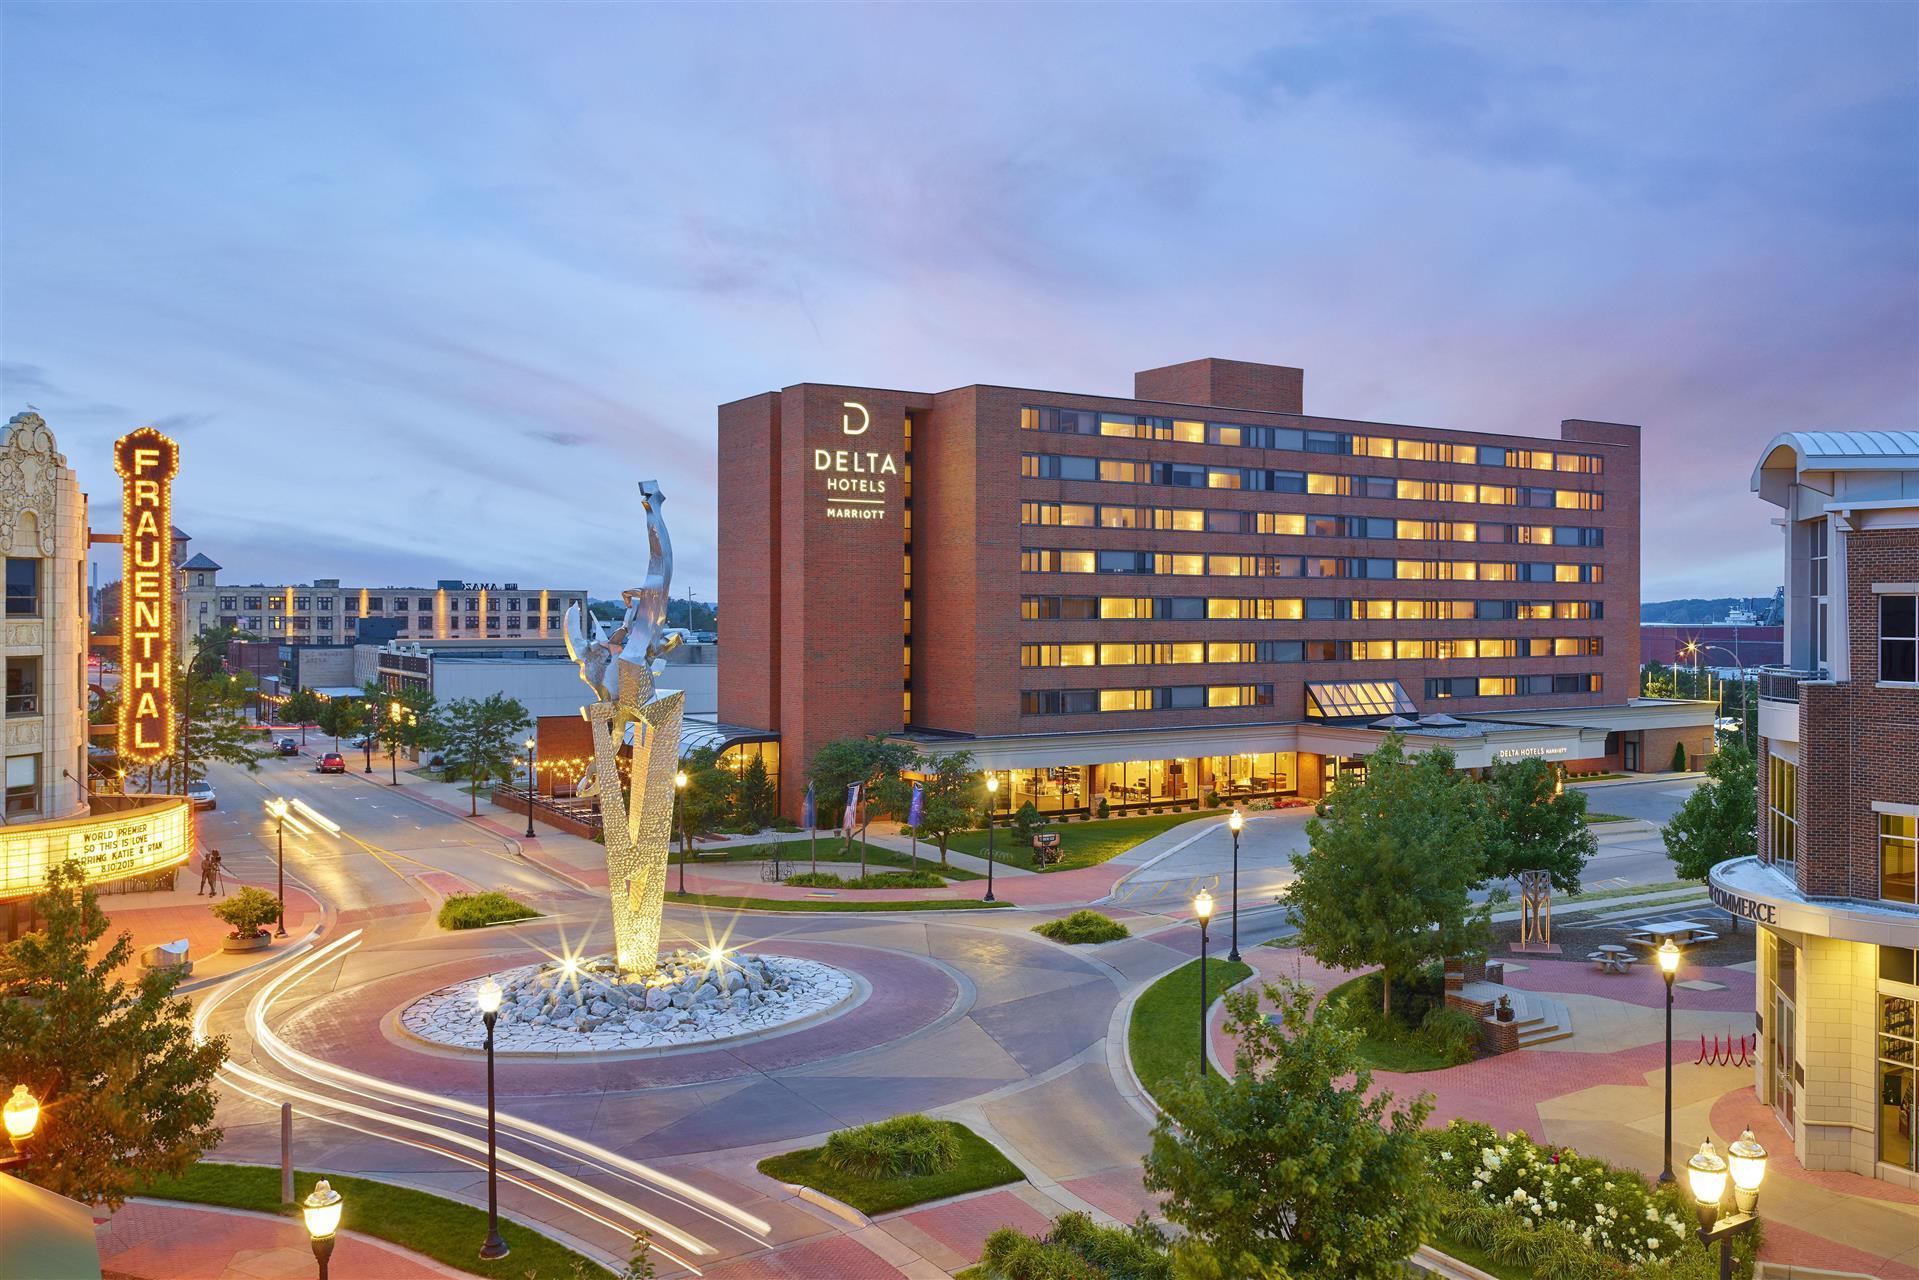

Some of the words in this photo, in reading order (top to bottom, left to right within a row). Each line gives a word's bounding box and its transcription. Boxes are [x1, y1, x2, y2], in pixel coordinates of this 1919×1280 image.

[815, 449, 897, 474] DELTA
[827, 478, 885, 493] HOTELS
[827, 508, 885, 519] MARRIOTT
[134, 449, 160, 748] FRAUENTHAL
[1500, 749, 1519, 758] DELTA
[1520, 747, 1545, 756] HOTELS
[84, 831, 113, 842] WORLD
[118, 824, 147, 836] PREMIER
[84, 844, 95, 854] SO
[101, 841, 118, 851] THIS
[121, 838, 129, 847] IS
[132, 834, 147, 845] LOVE
[112, 848, 134, 860] KATIE
[1714, 886, 1776, 924] COMMERCE
